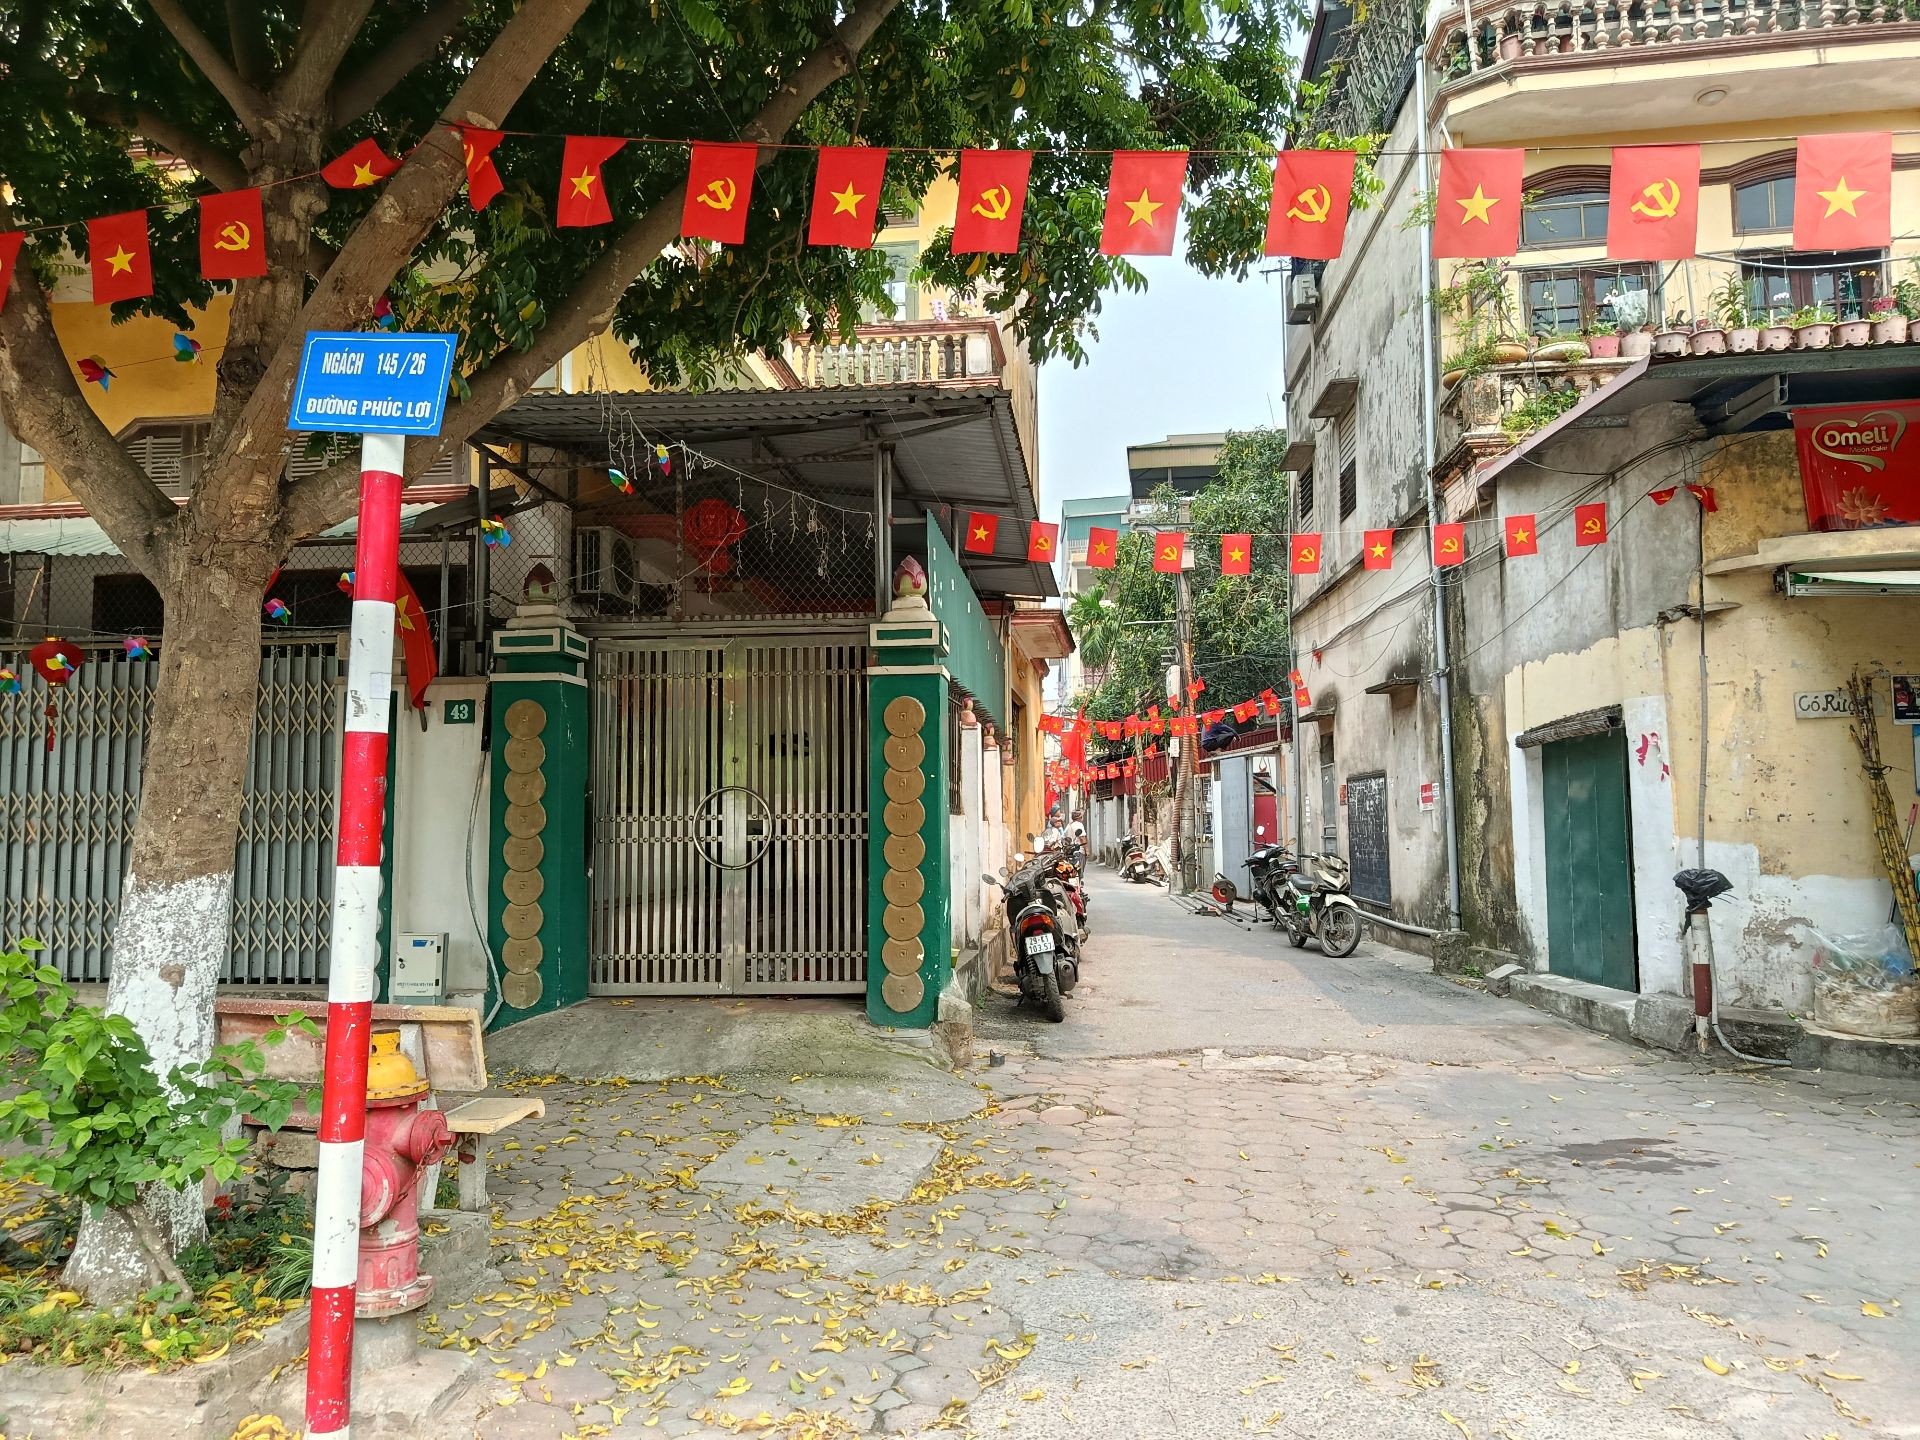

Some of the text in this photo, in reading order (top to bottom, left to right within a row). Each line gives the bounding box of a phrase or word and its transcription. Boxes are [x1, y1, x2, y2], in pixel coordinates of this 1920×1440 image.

[322, 348, 427, 379] NGÁCH 145/26
[306, 395, 432, 423] ĐƯỜNG PHÚC LỢI
[1823, 426, 1889, 447] Omeli
[1871, 444, 1888, 452] Cake
[450, 703, 469, 720] 43
